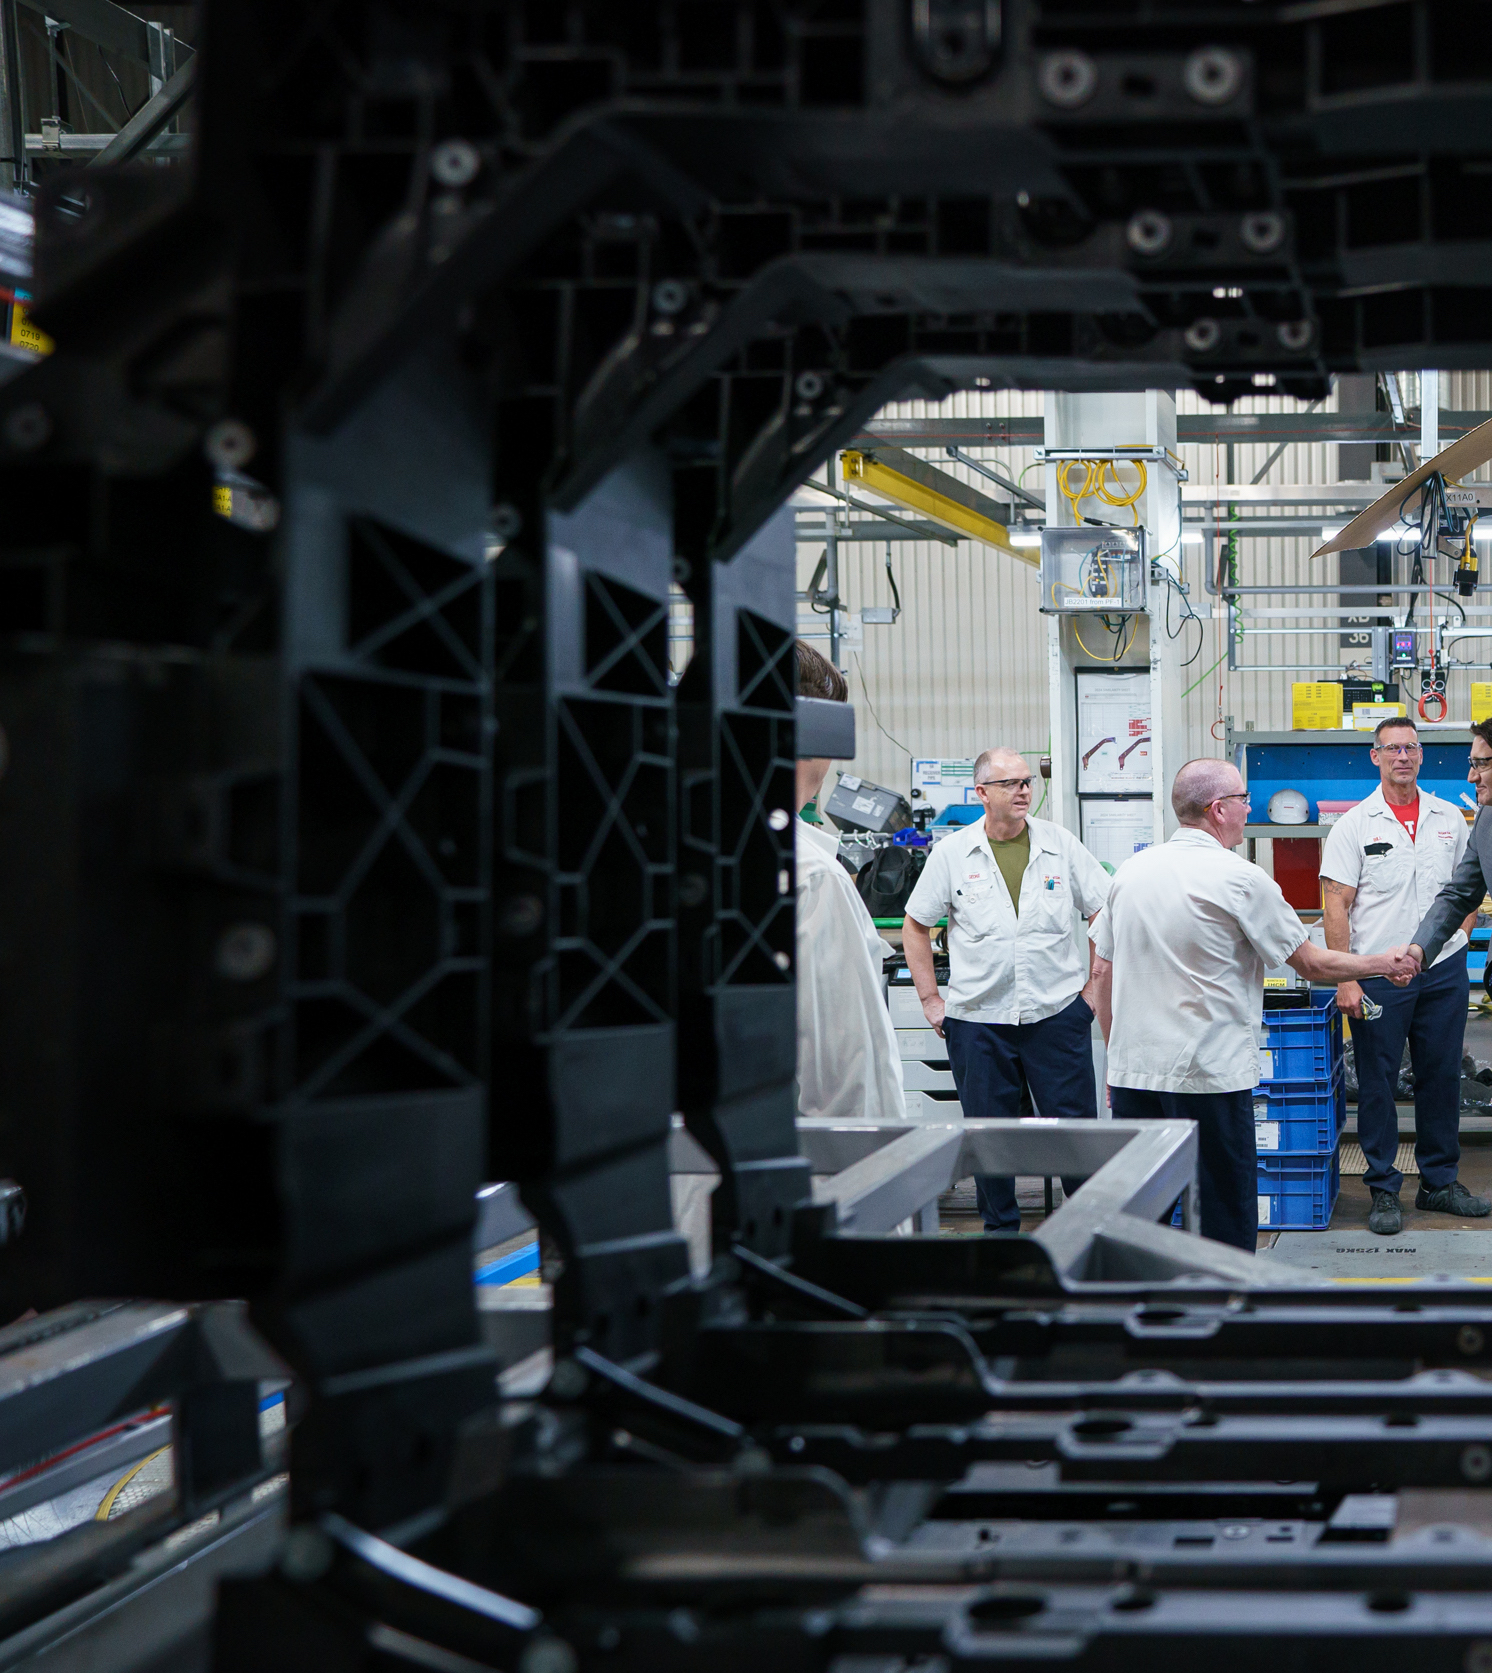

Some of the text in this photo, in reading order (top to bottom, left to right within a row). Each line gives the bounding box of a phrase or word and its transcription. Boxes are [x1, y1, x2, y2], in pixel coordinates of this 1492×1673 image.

[21, 329, 41, 340] 0719
[19, 340, 39, 352] 0720
[1446, 493, 1474, 502] X11A0
[1404, 820, 1415, 835] T
